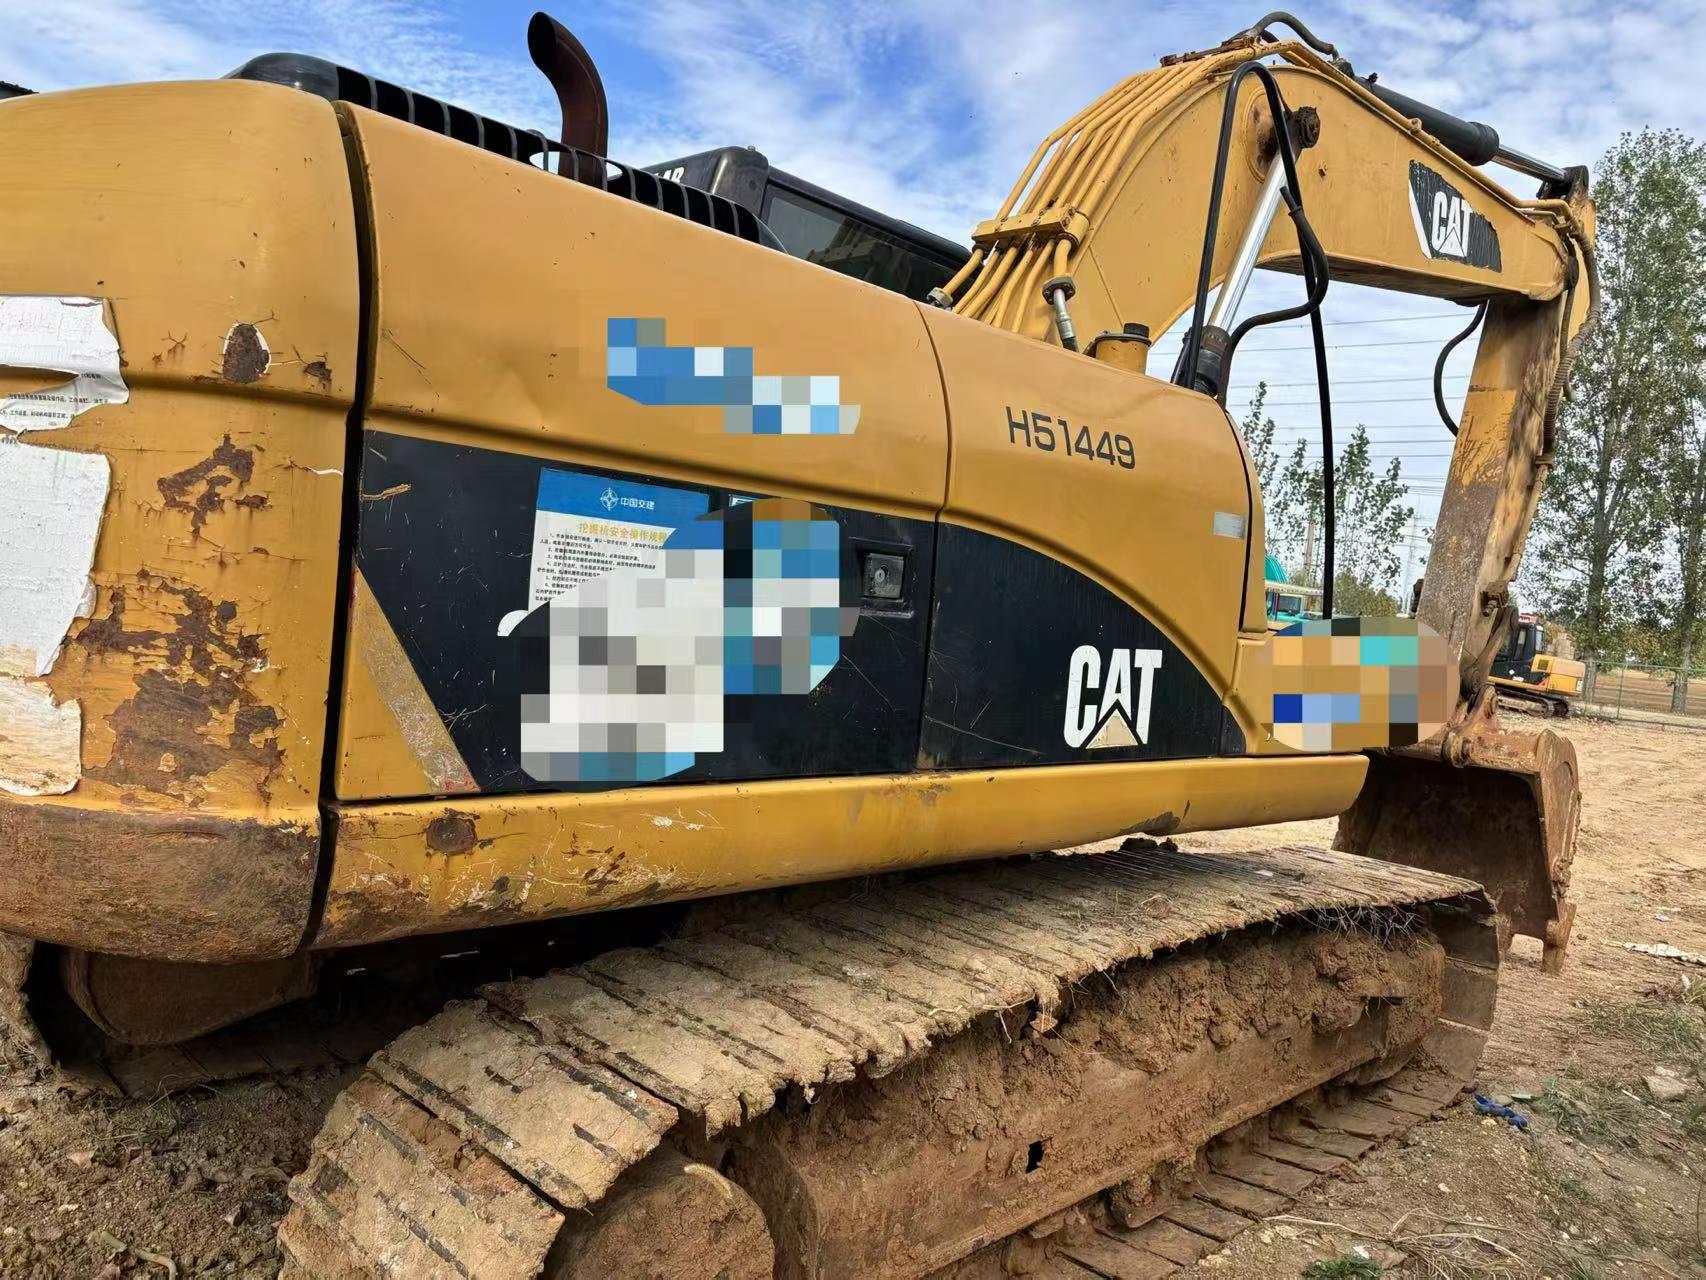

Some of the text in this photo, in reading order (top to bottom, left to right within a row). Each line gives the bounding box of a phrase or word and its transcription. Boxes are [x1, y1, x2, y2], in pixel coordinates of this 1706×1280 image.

[1431, 191, 1473, 257] CAT
[1006, 405, 1136, 470] H51449
[620, 497, 655, 510] 中国交建
[1063, 644, 1163, 749] CAT
